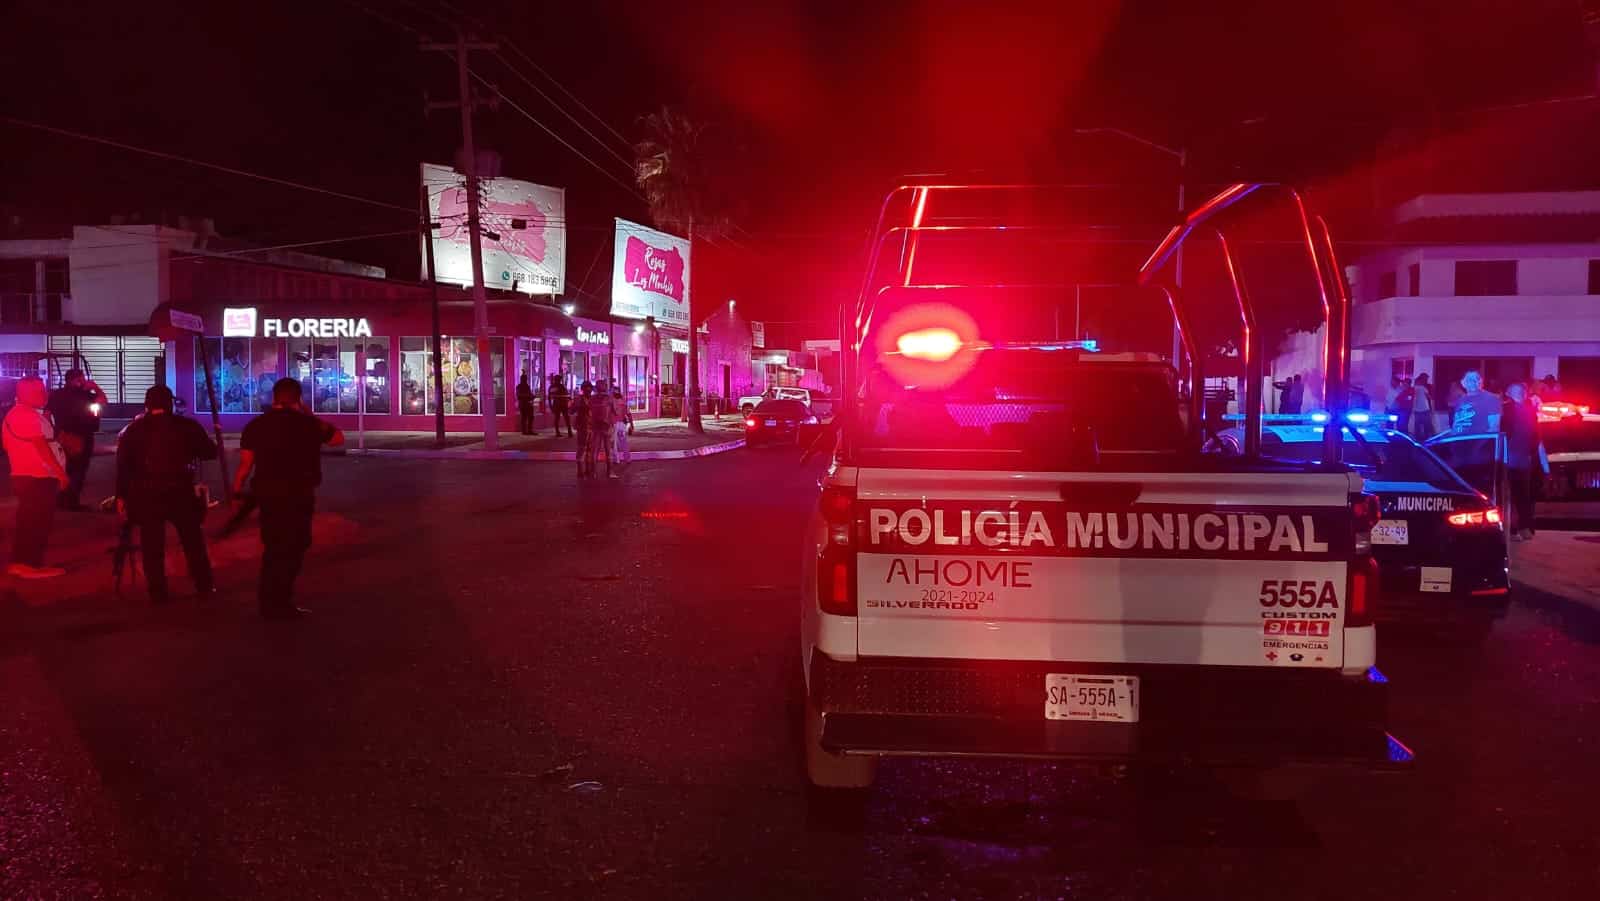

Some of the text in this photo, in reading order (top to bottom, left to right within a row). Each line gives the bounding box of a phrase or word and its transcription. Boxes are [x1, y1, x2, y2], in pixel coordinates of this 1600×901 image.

[263, 317, 372, 338] FLORERIA
[1397, 496, 1455, 511] MUNICIPAL
[869, 499, 1329, 553] POLICÍA MUNICIPAL
[886, 558, 1033, 588] AHOME
[920, 589, 995, 603] 2021-2024
[1259, 580, 1339, 609] 555A
[866, 600, 979, 610] SILVERADO
[1261, 611, 1337, 619] CUSTOM
[1266, 621, 1327, 636] 911
[1263, 640, 1329, 650] EMERGENCIAS
[1049, 686, 1135, 707] SA-555A-1
